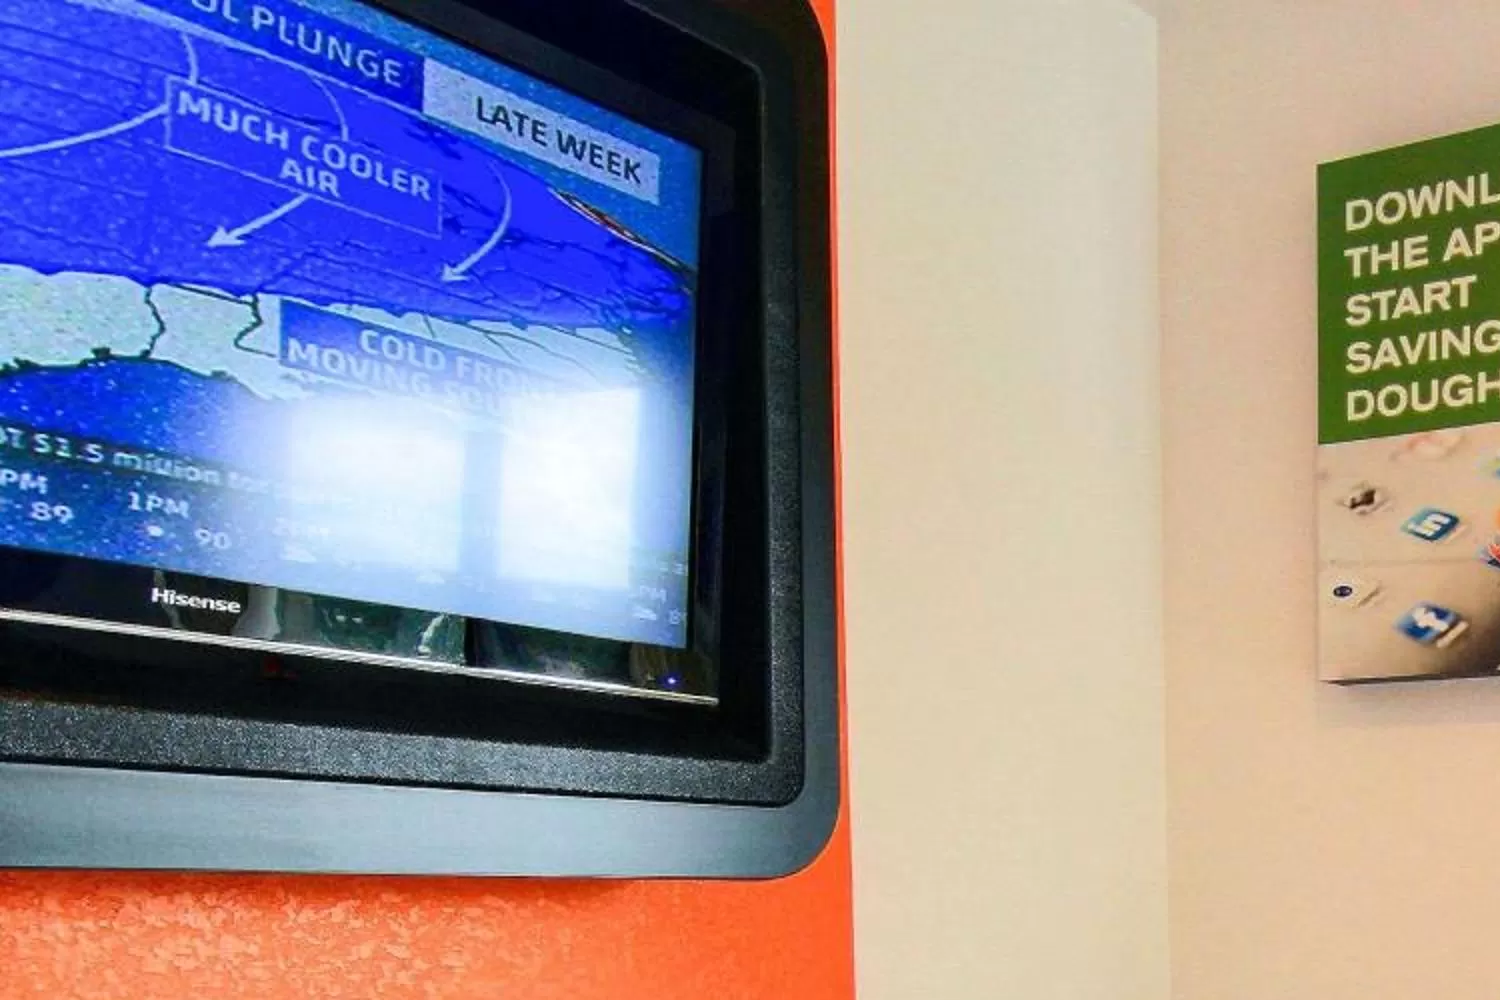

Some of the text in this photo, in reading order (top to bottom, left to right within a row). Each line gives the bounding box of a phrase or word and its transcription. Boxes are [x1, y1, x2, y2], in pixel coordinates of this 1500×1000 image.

[251, 4, 403, 87] PLUNGE
[178, 91, 431, 201] MUCH COOLER
[475, 96, 642, 186] LATE WEEK
[279, 157, 341, 198] AIR
[1344, 235, 1429, 278] THE
[1345, 275, 1477, 327] START
[288, 337, 431, 395] MOVING
[359, 329, 446, 371] COLD
[112, 452, 220, 486] million
[30, 501, 232, 550] 89 90
[127, 491, 189, 518] 1PM
[151, 587, 242, 613] Hisense
